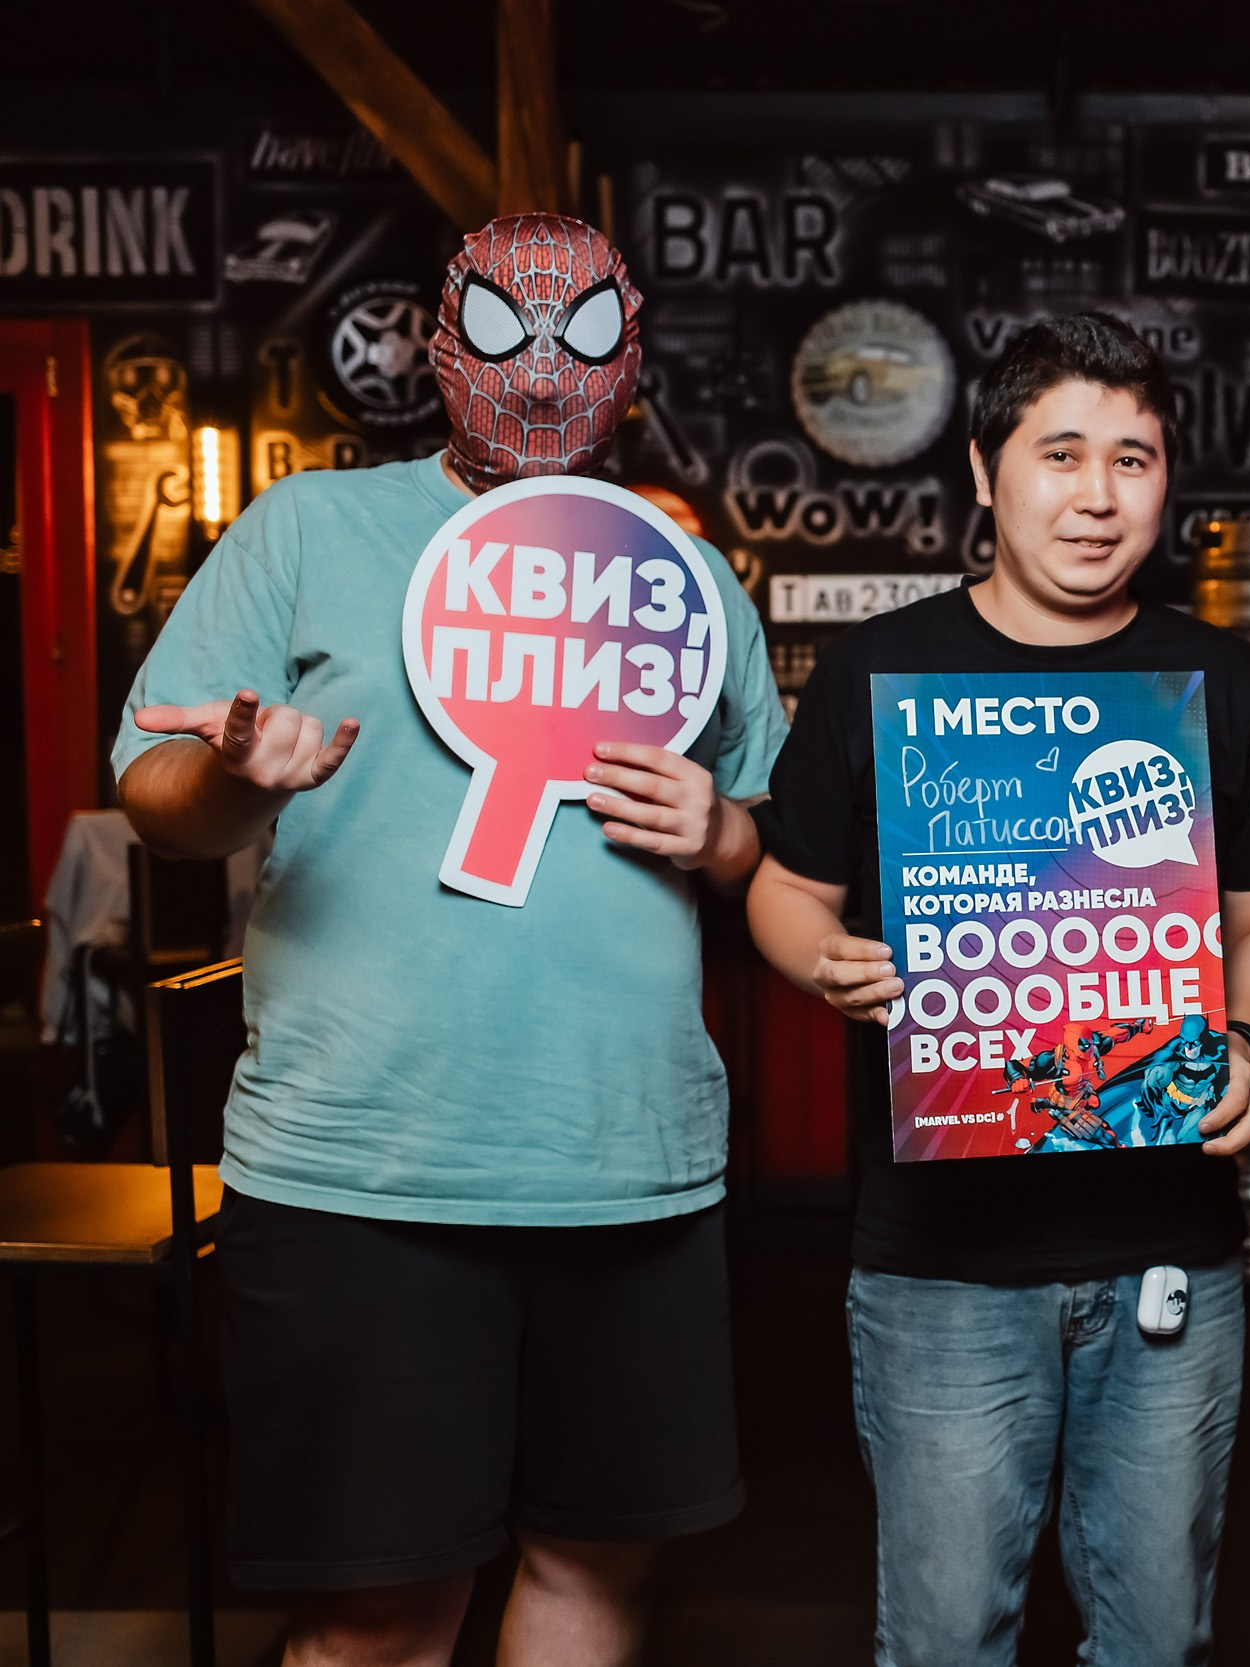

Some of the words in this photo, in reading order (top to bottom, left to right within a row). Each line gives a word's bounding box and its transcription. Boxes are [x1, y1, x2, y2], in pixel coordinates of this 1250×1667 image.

[0, 186, 196, 278] DRINK
[655, 196, 836, 281] BAR
[446, 539, 709, 647] КВИЗ,
[430, 625, 704, 719] ПЛИЗ!
[897, 698, 917, 736] 1
[933, 696, 1100, 736] МЕСТО
[901, 746, 1023, 818] Роберт
[1071, 755, 1191, 814] КВИЗ,
[928, 810, 1084, 853] Патиссон
[1080, 787, 1196, 850] ПЛИЗ!
[902, 863, 1037, 887] КОМАНДЕ,
[903, 893, 1023, 916] КОТОРАЯ
[1027, 887, 1157, 912] РАЗНЕСЛА
[910, 1028, 1037, 1074] ВСЕХ
[914, 1115, 961, 1129] [MARVEL
[961, 1113, 976, 1124] VS
[976, 1111, 996, 1124] DC]
